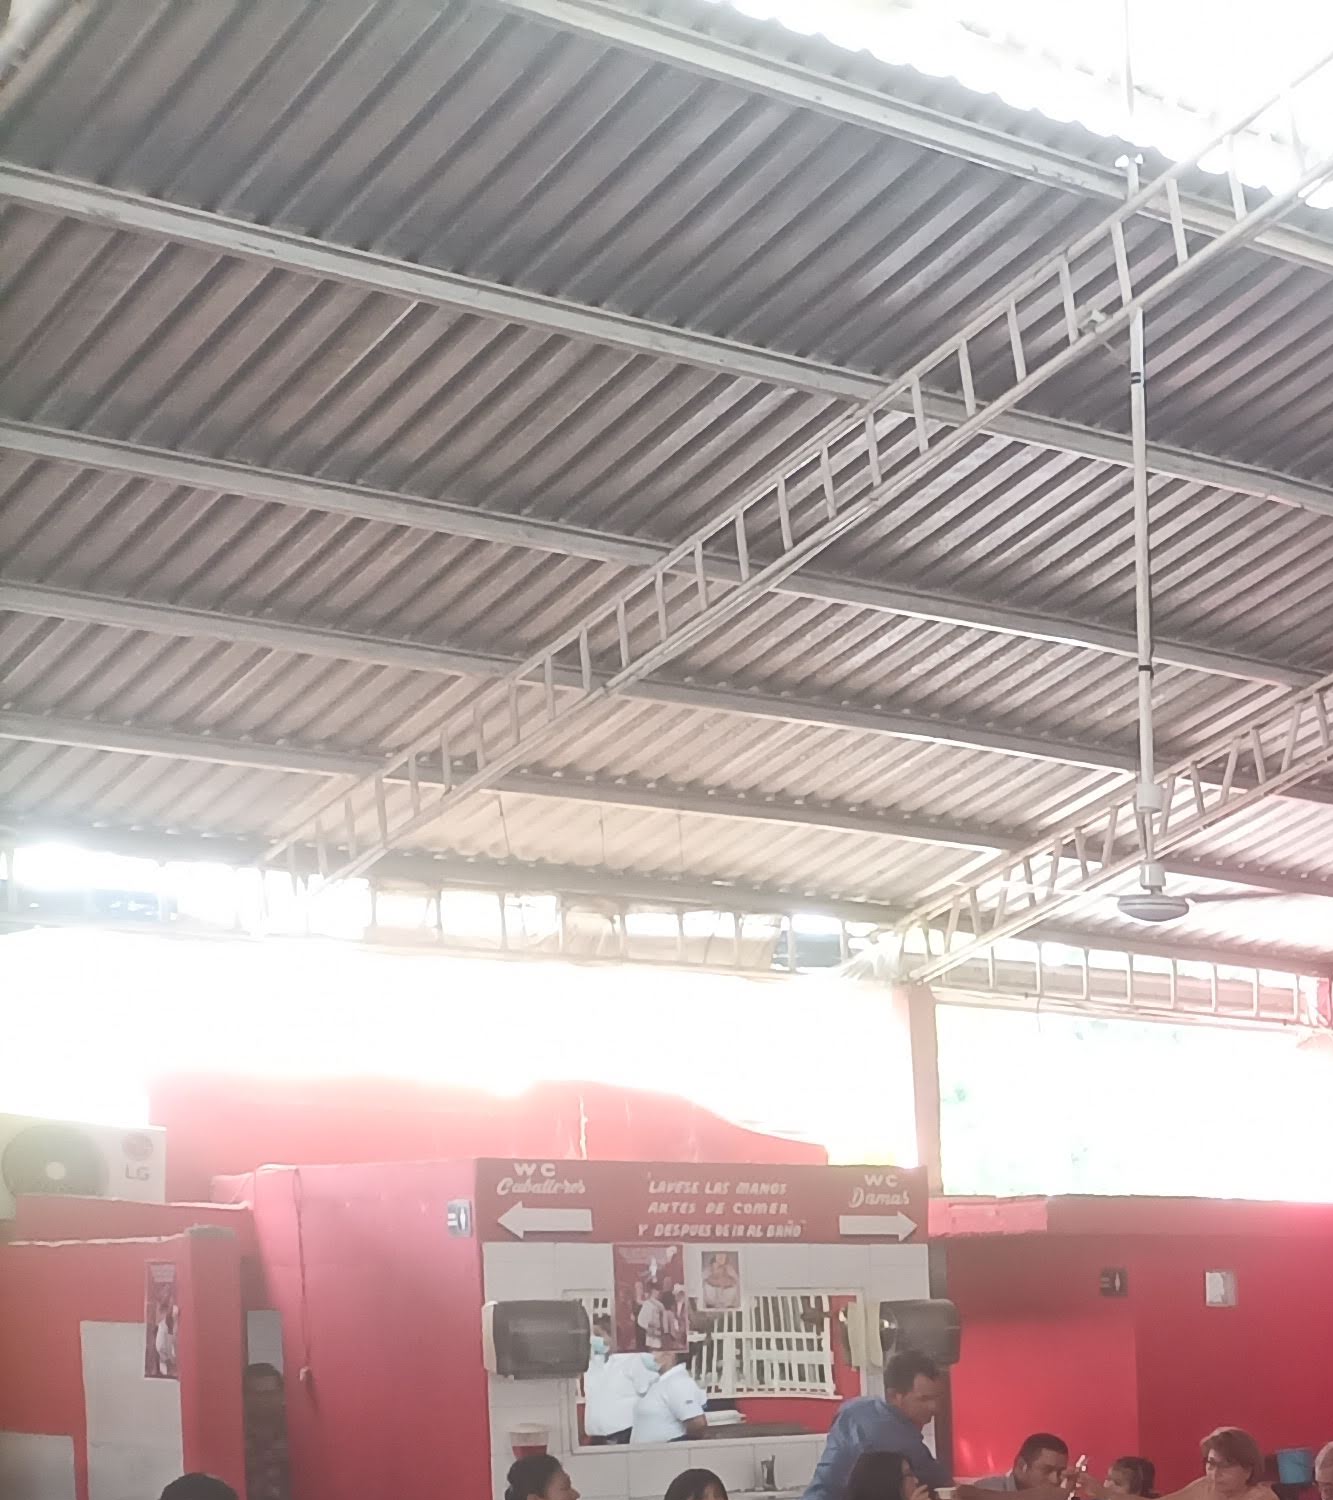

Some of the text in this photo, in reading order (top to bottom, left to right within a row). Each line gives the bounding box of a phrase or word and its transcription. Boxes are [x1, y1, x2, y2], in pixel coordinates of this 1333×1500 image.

[125, 1163, 150, 1181] LG
[704, 1181, 730, 1195] LAS
[735, 1182, 787, 1195] MANOS
[848, 1186, 911, 1209] Damas
[647, 1201, 789, 1215] ANTES DE COMER
[638, 1223, 648, 1236] Y
[653, 1223, 711, 1237] DESPUES
